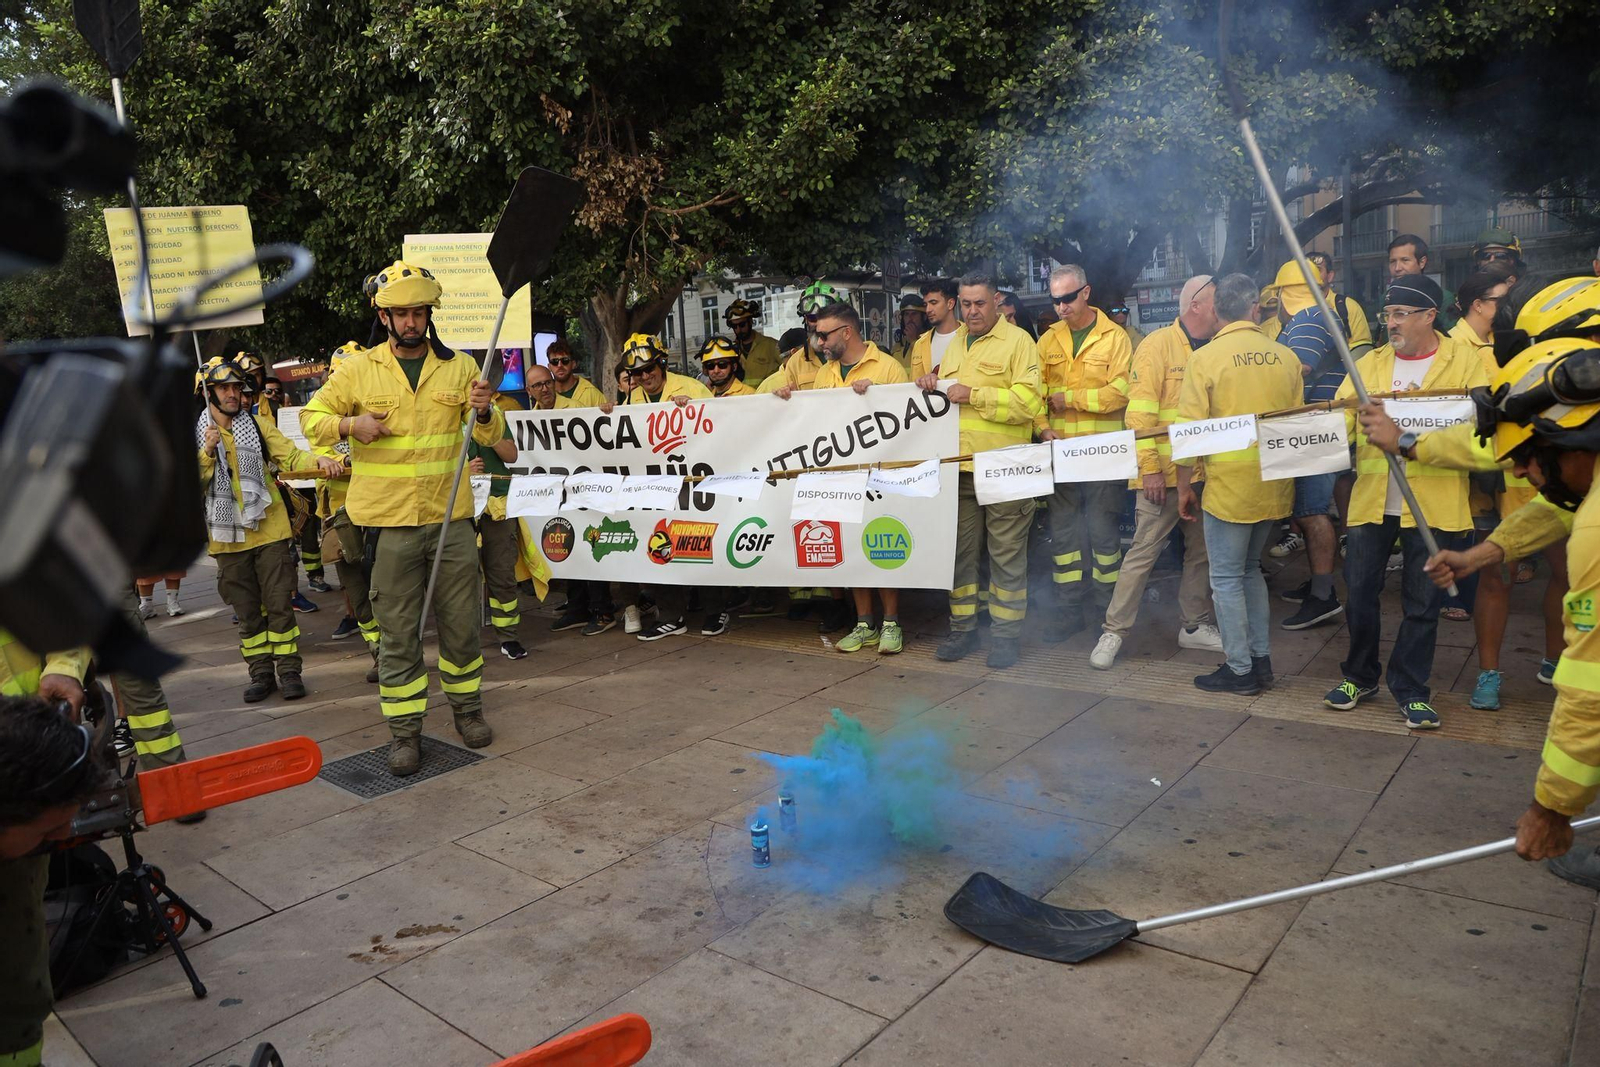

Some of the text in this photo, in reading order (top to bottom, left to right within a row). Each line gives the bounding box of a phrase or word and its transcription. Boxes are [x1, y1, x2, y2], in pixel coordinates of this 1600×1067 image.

[191, 209, 222, 217] MORENO
[167, 225, 203, 233] NUESTROS
[188, 268, 226, 277] MOVILIDAD
[196, 297, 230, 306] COLECTIVA
[1232, 351, 1283, 367] INFOCA
[515, 404, 714, 451] INFOCA 100%
[1174, 418, 1251, 438] ANDALUCÍA
[1267, 432, 1340, 450] SE QUEMA
[1062, 444, 1128, 458] VENDIDOS
[985, 464, 1042, 478] ESTAMOS
[873, 469, 937, 486] INCOMPLETO
[516, 488, 555, 498] JUANMA
[572, 484, 613, 494] MORENO
[633, 484, 678, 494] VACACIONES
[797, 490, 862, 501] DISPOSITIVO
[670, 523, 715, 537] MOVIMIENTO
[549, 533, 567, 544] CGT
[675, 535, 712, 552] INFOCA
[735, 533, 775, 552] CSIF
[865, 533, 909, 548] UITA
[805, 545, 836, 553] CCOO
[806, 553, 822, 563] EMA
[1567, 599, 1592, 611] 112
